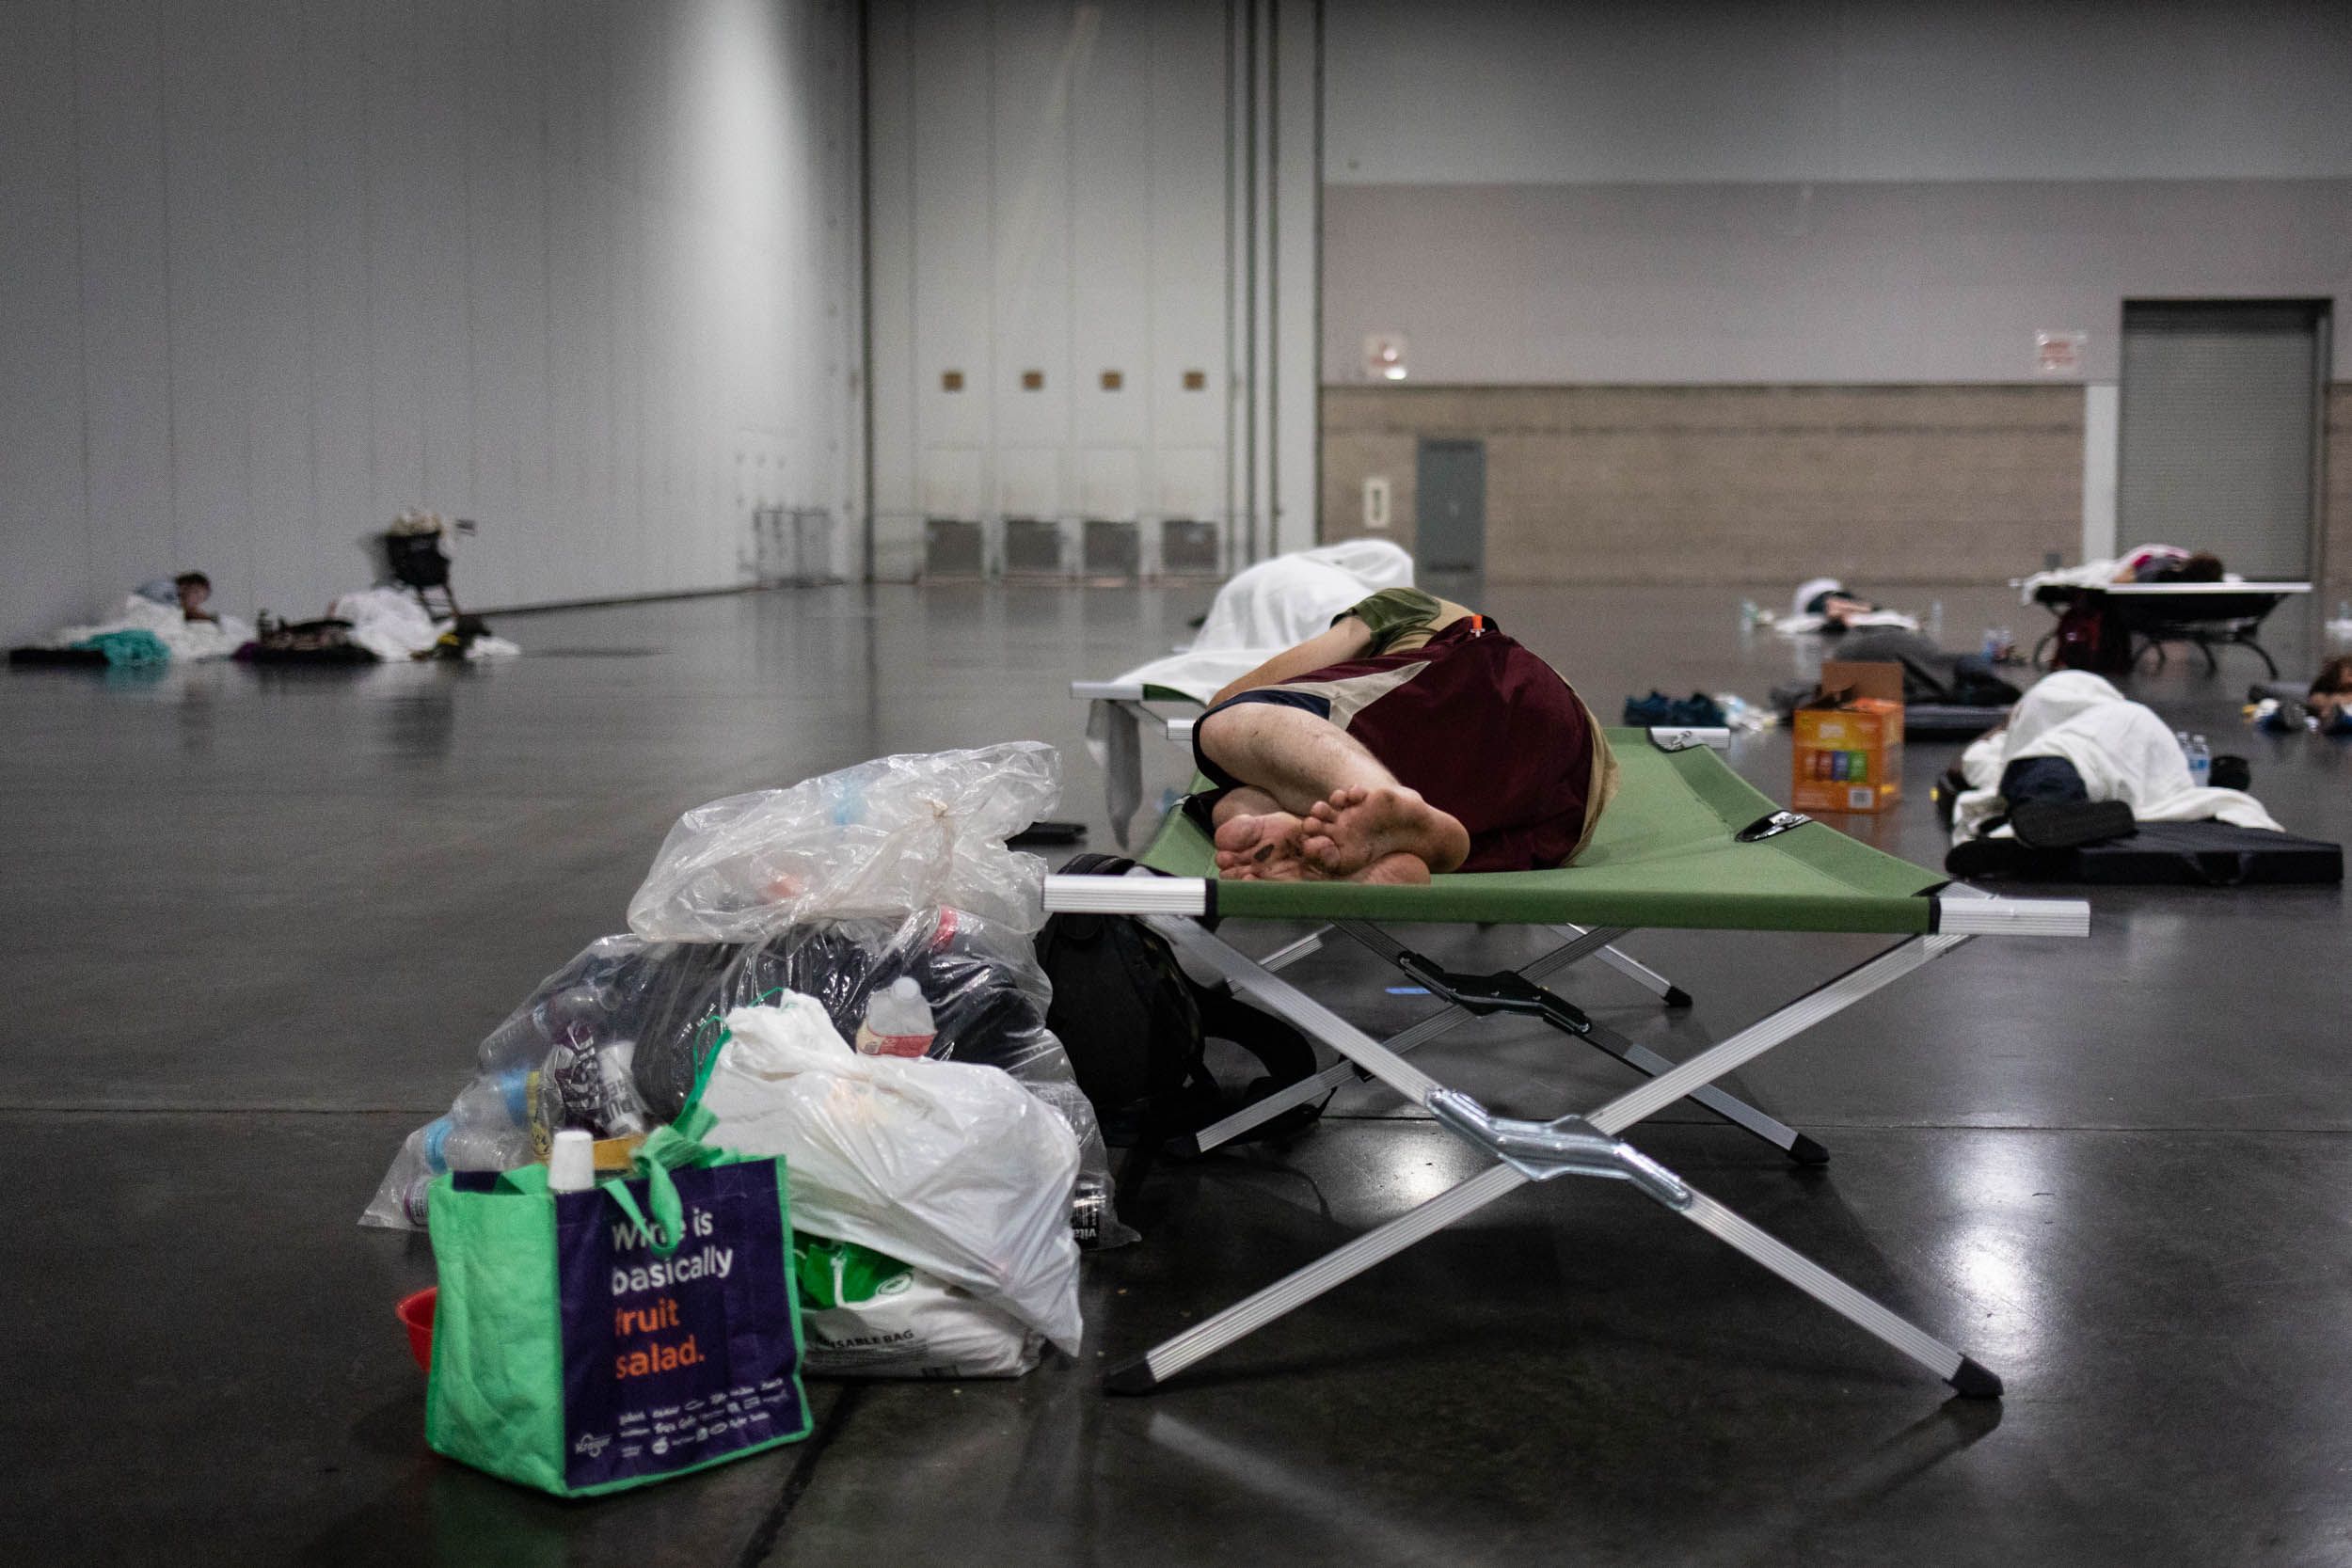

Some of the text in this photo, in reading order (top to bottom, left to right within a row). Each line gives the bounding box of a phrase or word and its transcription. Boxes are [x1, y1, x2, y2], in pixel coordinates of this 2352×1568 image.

[692, 1207, 714, 1237] is
[612, 1244, 734, 1296] basically
[882, 1329, 914, 1344] BAG
[615, 1334, 706, 1380] salad.
